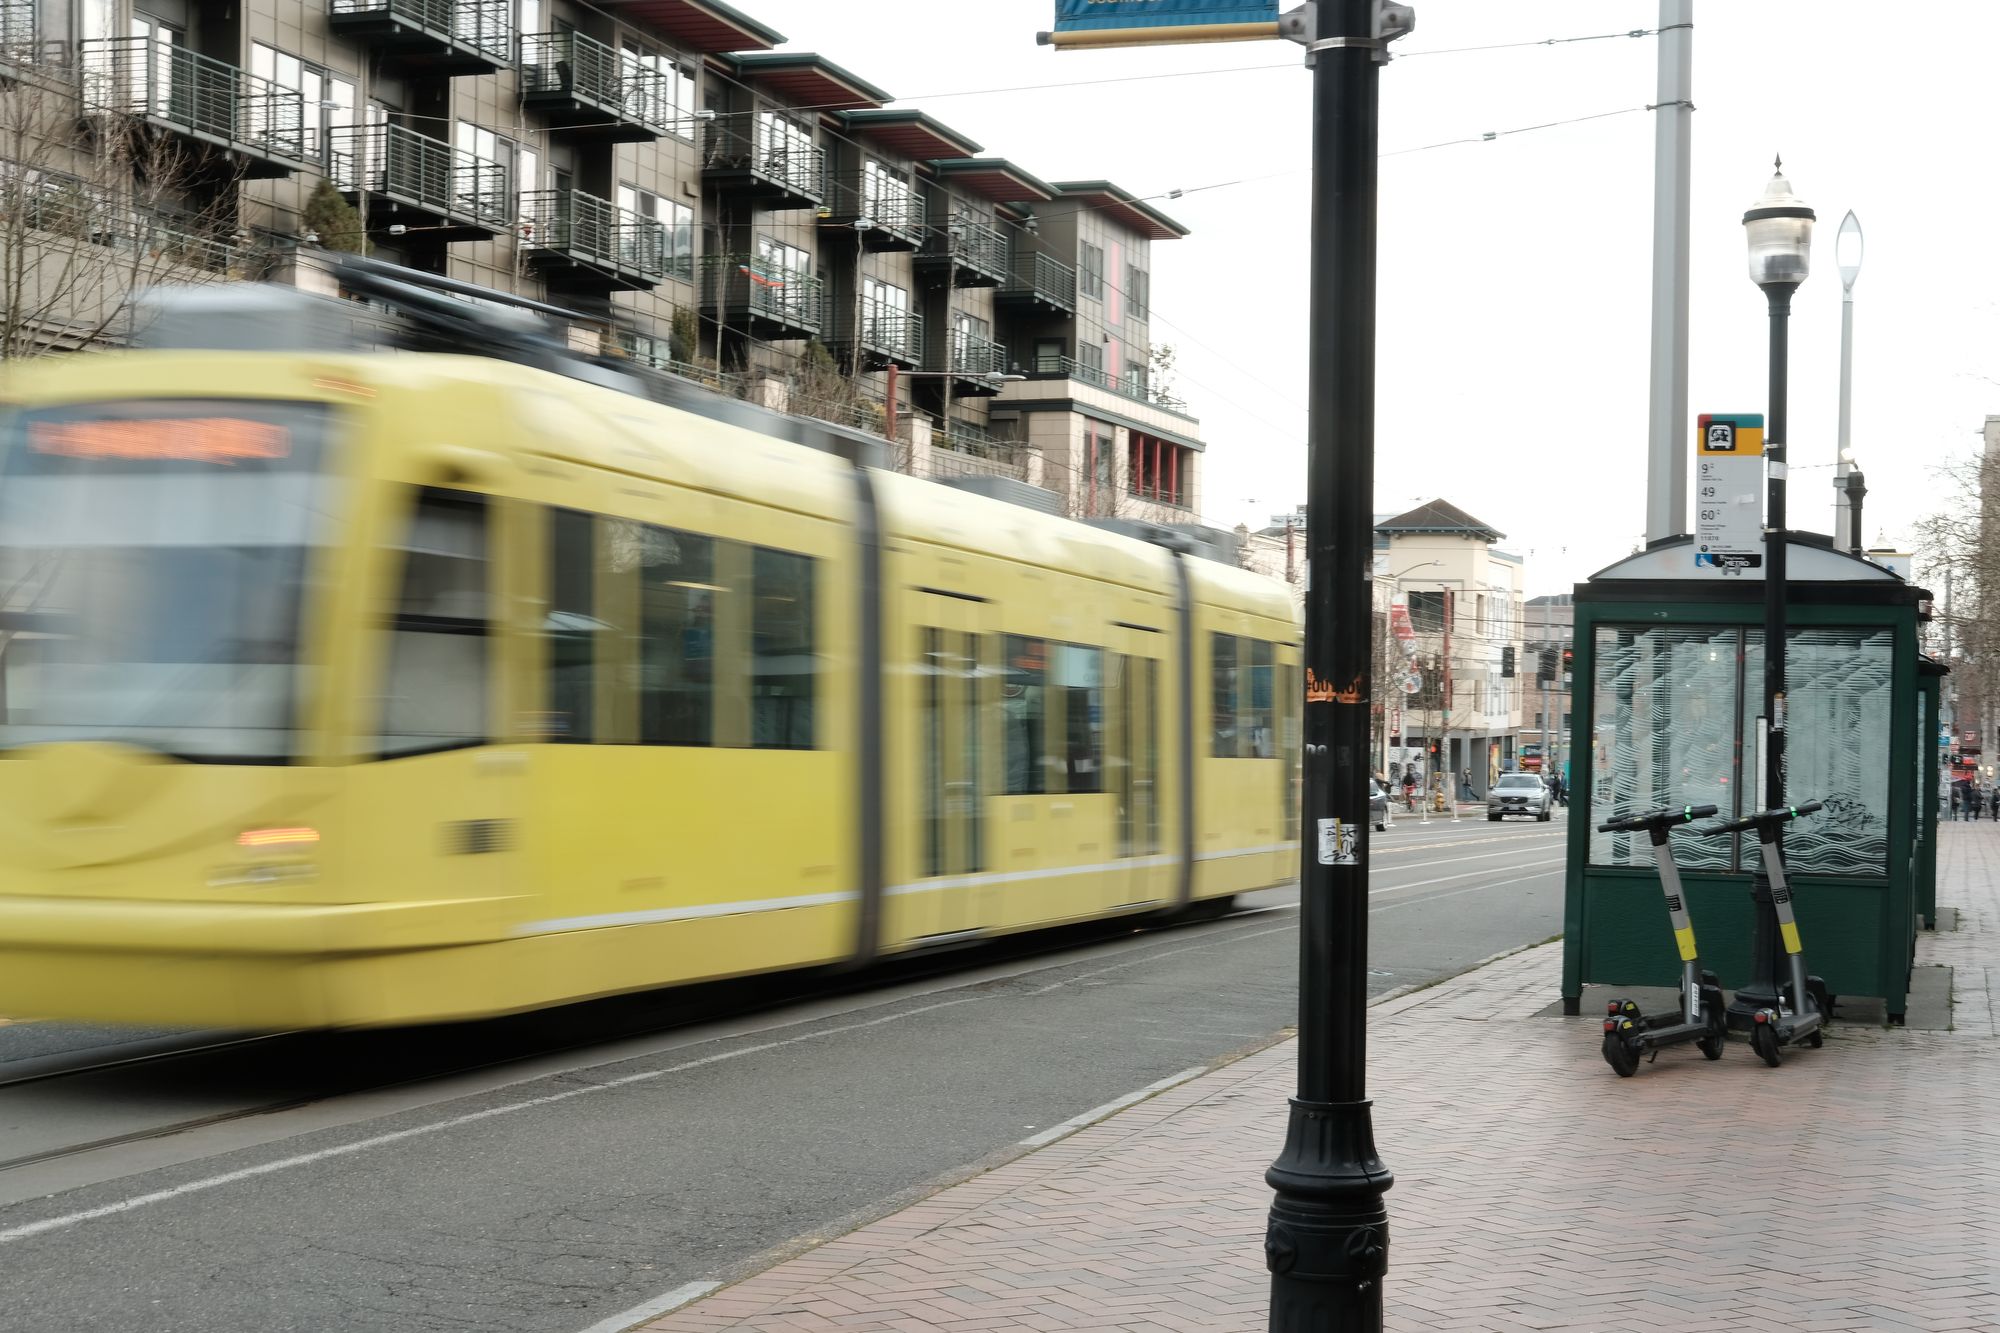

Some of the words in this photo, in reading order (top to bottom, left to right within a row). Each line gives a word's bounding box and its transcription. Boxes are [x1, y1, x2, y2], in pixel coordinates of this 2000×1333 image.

[1701, 463, 1708, 474] 9
[1701, 486, 1715, 497] 49
[1701, 509, 1714, 520] 60
